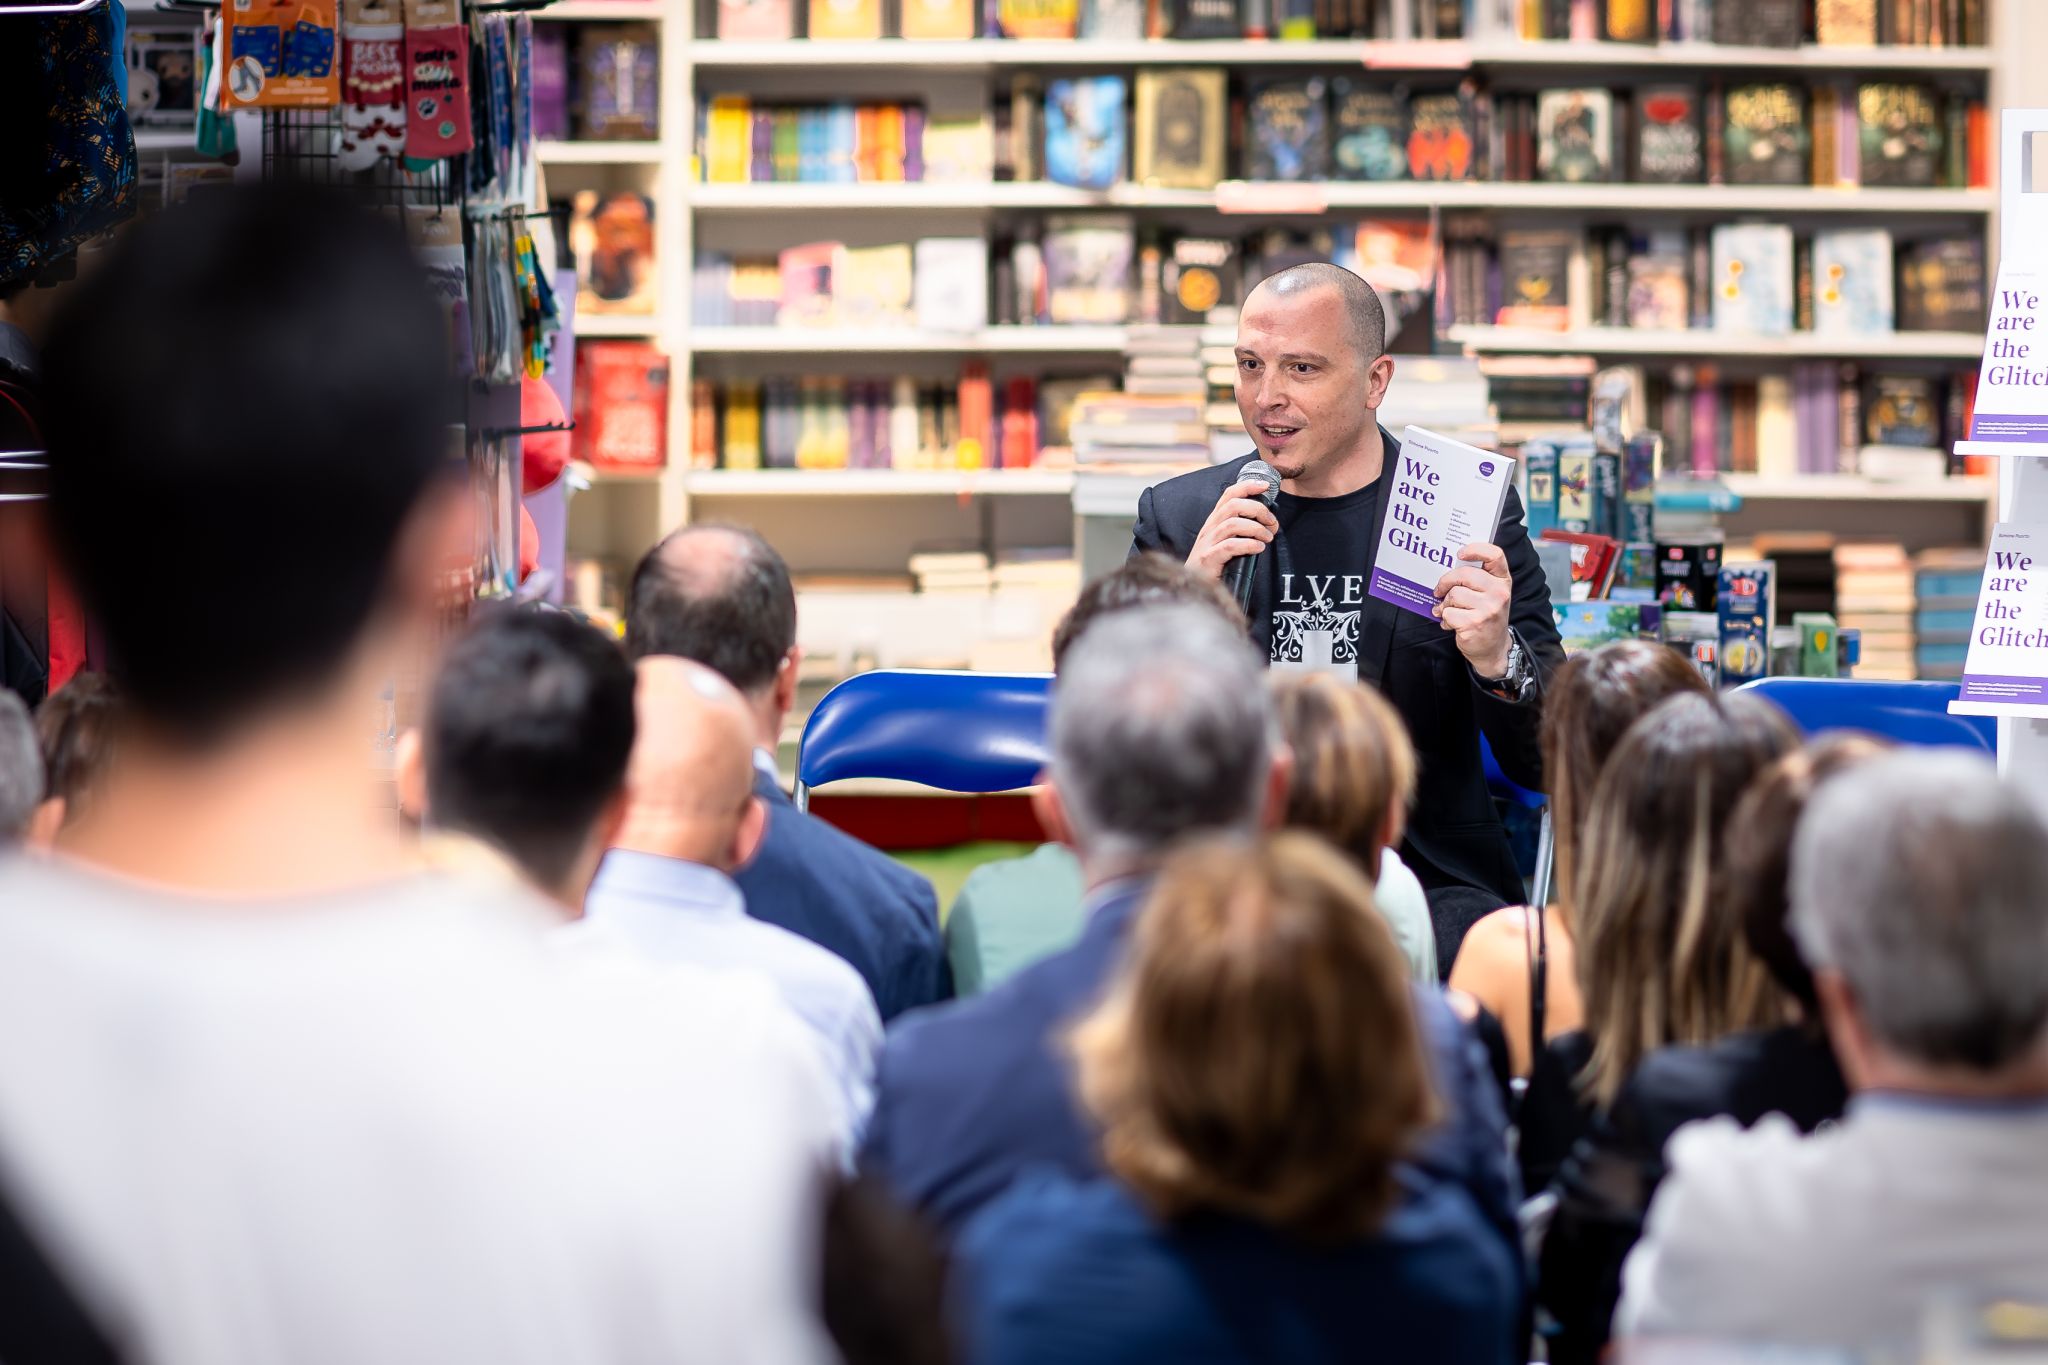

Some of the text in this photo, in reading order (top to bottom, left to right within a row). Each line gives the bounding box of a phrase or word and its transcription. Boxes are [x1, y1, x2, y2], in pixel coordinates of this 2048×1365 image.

[2002, 290, 2039, 310] We
[1996, 316, 2035, 331] are
[1992, 338, 2030, 358] the
[1404, 457, 1440, 486] We
[1398, 481, 1435, 506] are
[1393, 503, 1428, 531] the
[1388, 527, 1454, 569] Glitch
[1994, 551, 2033, 571] We
[1989, 577, 2028, 592] are
[1984, 599, 2022, 620] the
